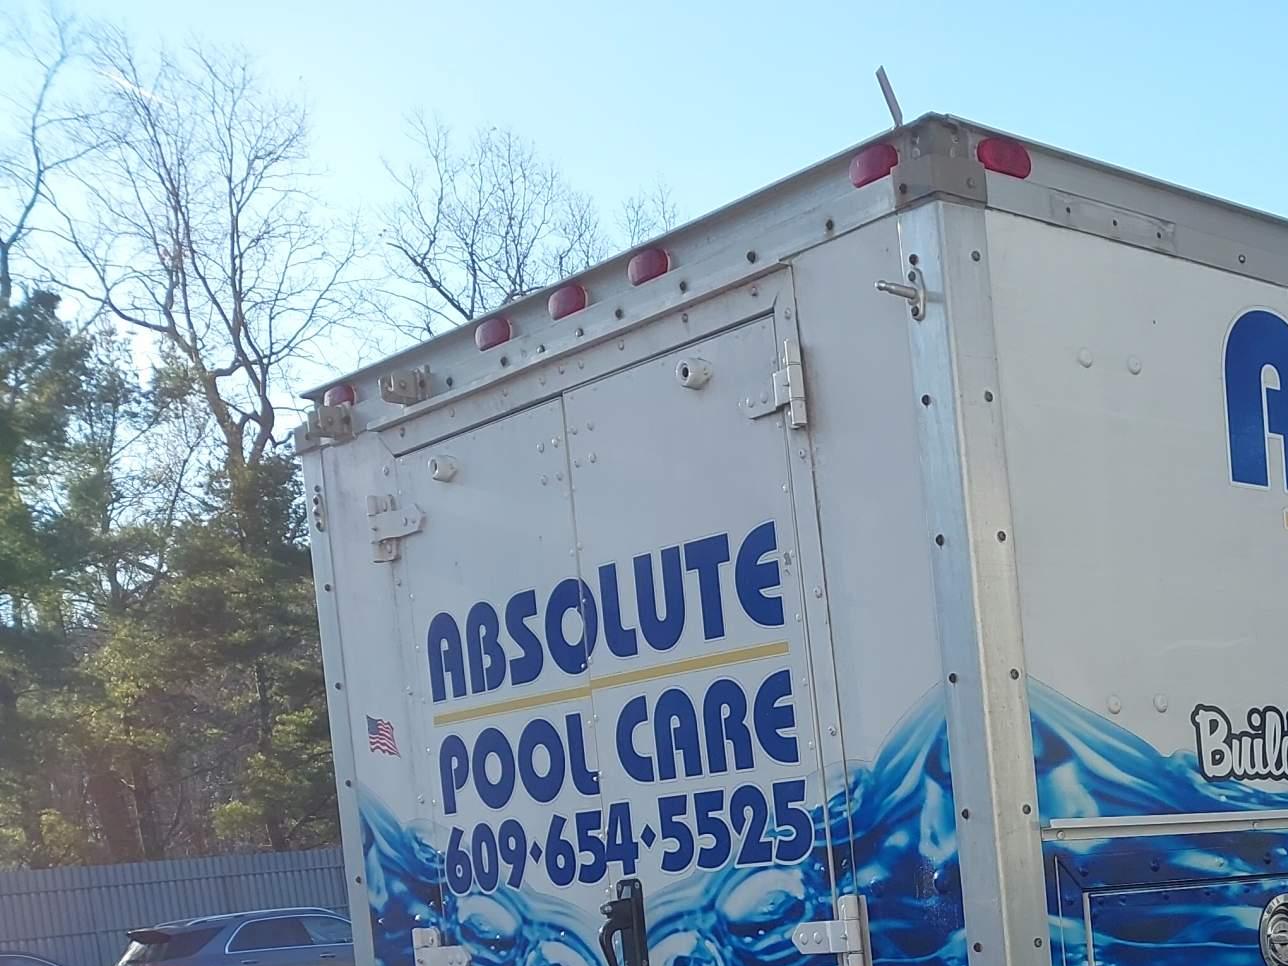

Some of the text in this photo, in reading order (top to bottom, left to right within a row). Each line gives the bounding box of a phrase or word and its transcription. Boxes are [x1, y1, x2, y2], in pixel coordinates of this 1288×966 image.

[427, 520, 785, 702] ABSOLUTE
[439, 669, 799, 815] POOL CARE
